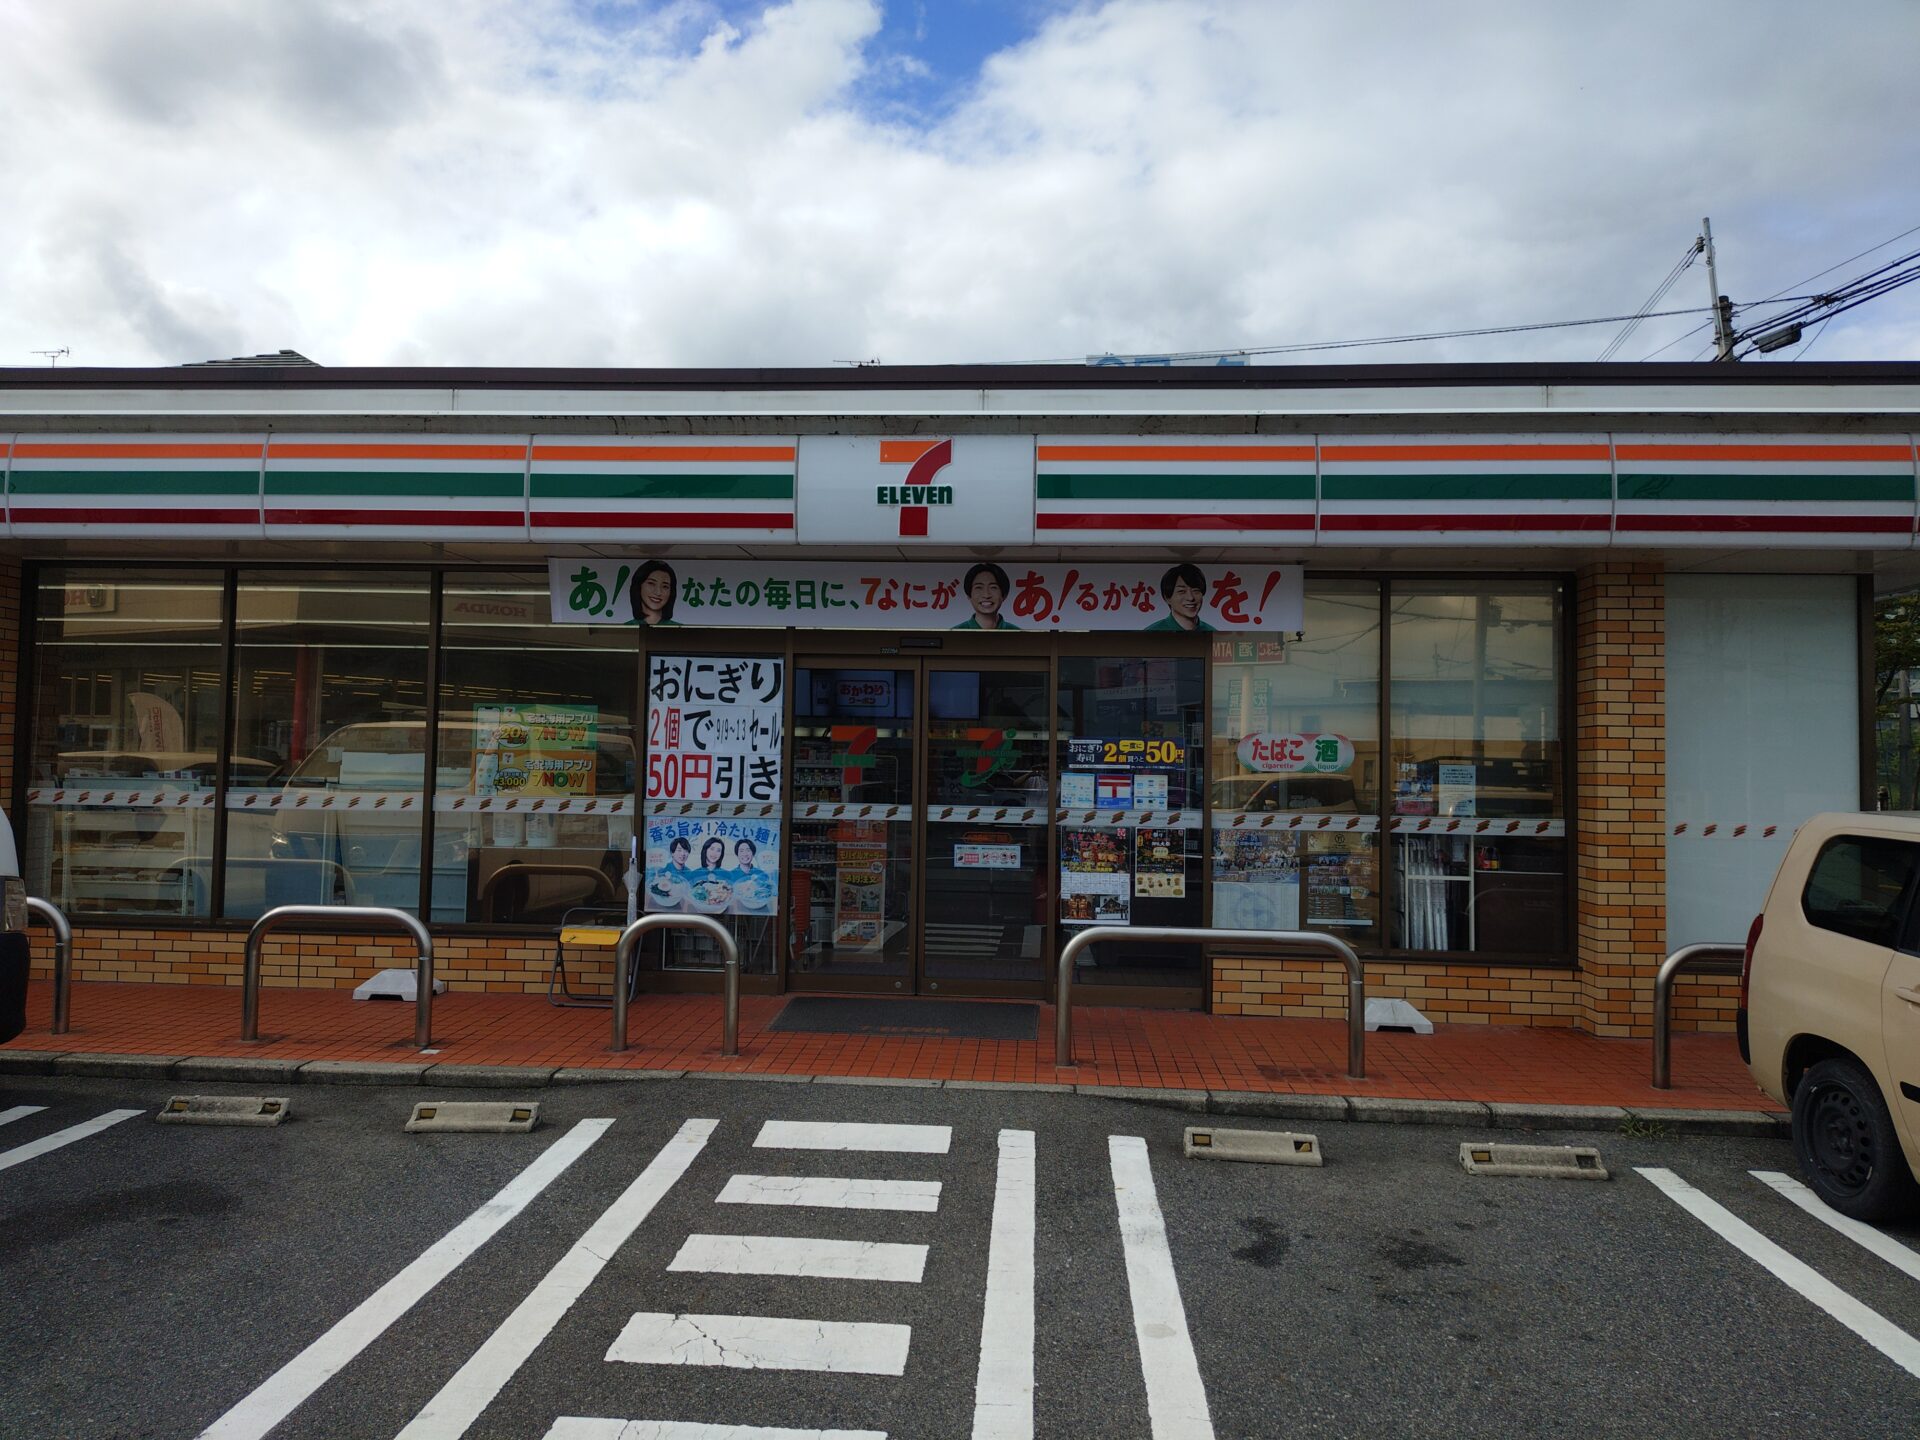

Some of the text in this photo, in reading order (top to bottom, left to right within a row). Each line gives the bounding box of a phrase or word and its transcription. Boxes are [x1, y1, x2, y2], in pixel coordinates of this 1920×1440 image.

[880, 438, 953, 535] 7
[651, 658, 782, 704] おにぎり
[840, 683, 884, 696] おかわり
[650, 706, 713, 751] 2個で
[1069, 744, 1102, 753] おにぎり
[1251, 738, 1305, 761] たばこ
[1314, 739, 1338, 762] 酒
[525, 759, 593, 772] 宅配専用アプリ
[1075, 753, 1095, 763] 寿司
[1262, 762, 1295, 770] cigarette
[1317, 763, 1339, 772] liquor
[648, 754, 778, 800] 50円引き
